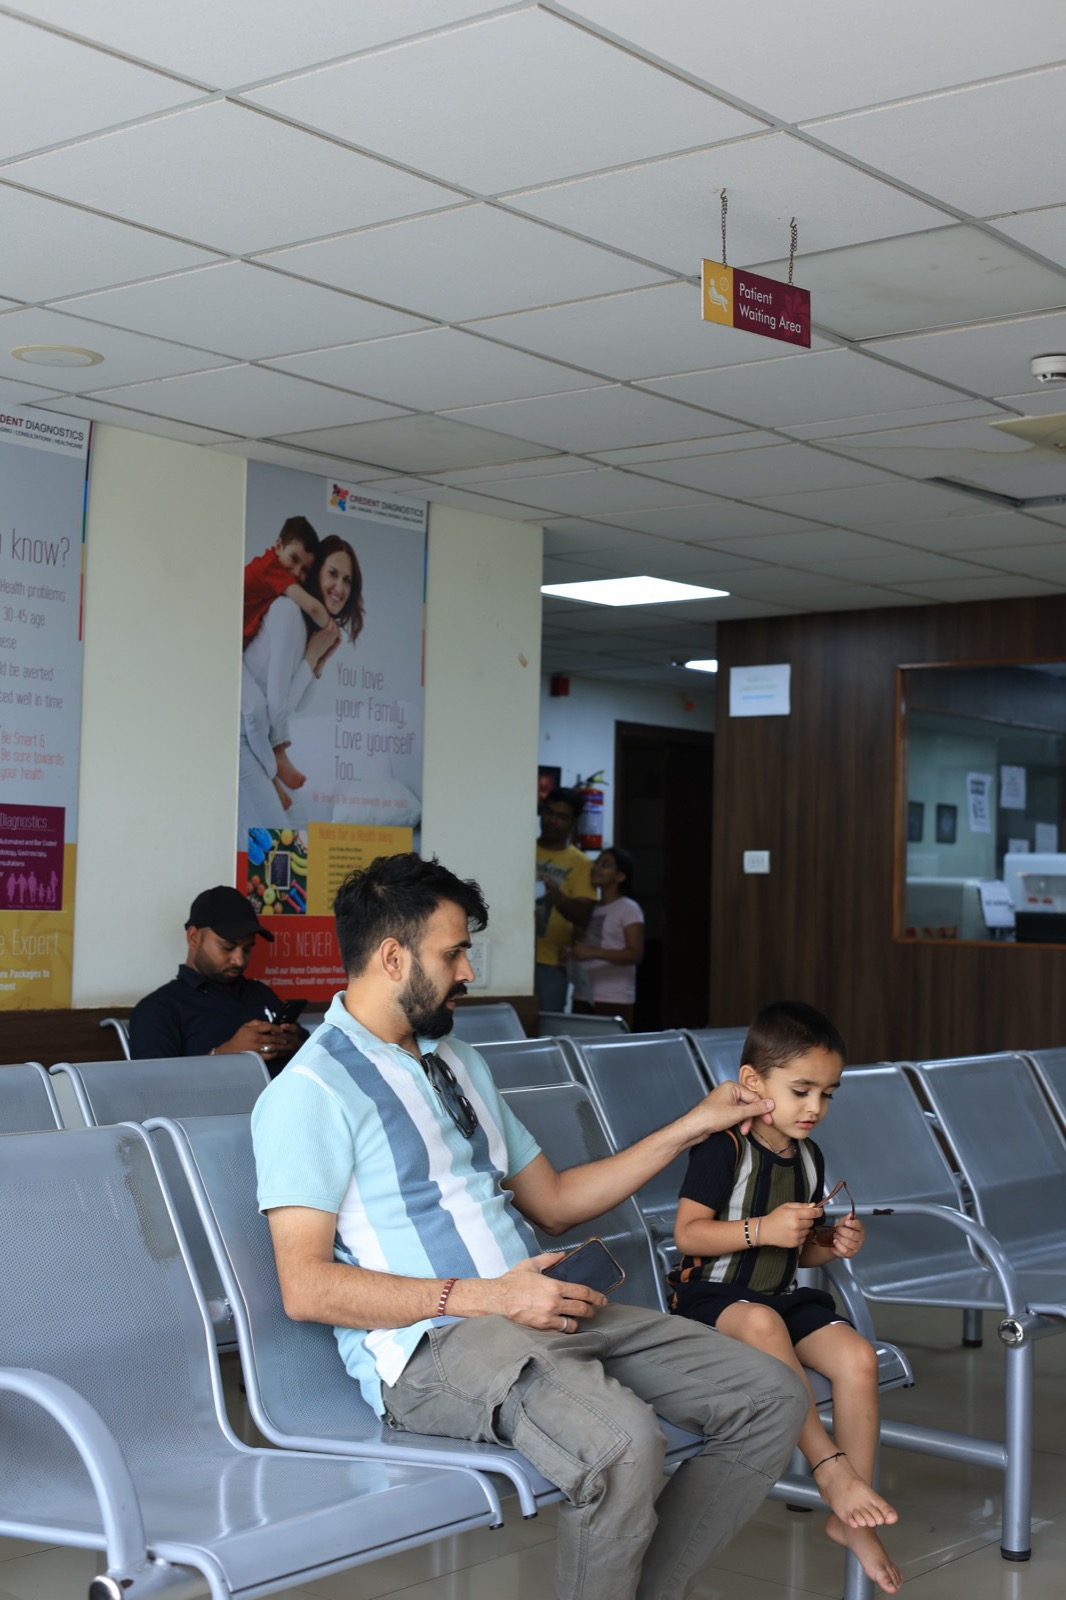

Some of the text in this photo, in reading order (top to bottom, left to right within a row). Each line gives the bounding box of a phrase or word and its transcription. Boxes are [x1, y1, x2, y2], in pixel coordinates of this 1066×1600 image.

[739, 282, 773, 305] Patient
[739, 302, 802, 334] Waiting Area
[25, 419, 84, 441] DIAGNOSTICS
[11, 527, 70, 568] know?
[28, 583, 66, 602] problems
[3, 606, 46, 629] 30-45 age
[9, 661, 20, 677] be
[23, 666, 54, 682] averted
[336, 661, 384, 691] You love
[16, 691, 32, 706] well
[335, 698, 364, 723] your
[335, 724, 416, 757] Love yourself
[12, 928, 60, 961] Expert
[269, 931, 332, 957] IT'S NEVER
